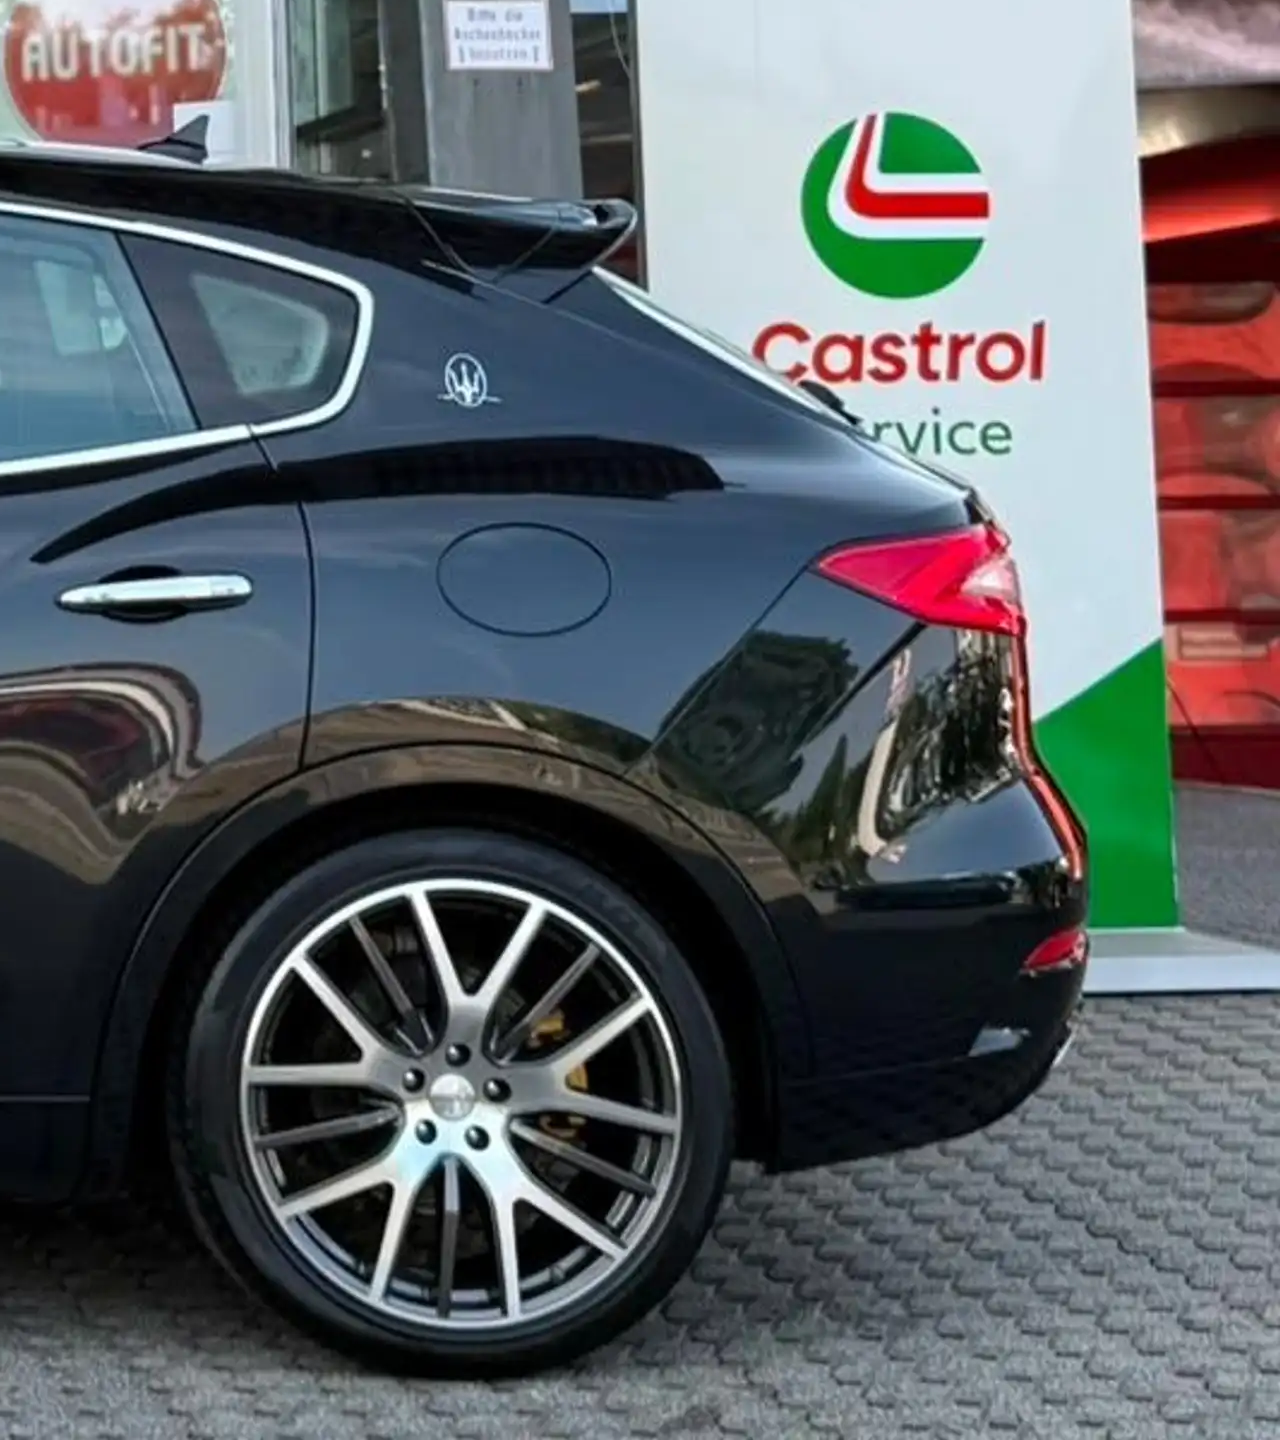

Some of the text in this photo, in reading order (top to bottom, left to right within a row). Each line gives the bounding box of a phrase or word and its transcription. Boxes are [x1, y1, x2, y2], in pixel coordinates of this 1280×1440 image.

[21, 24, 205, 82] AUTOFIT
[751, 319, 1047, 383] Castrol
[864, 407, 1013, 455] rvice
